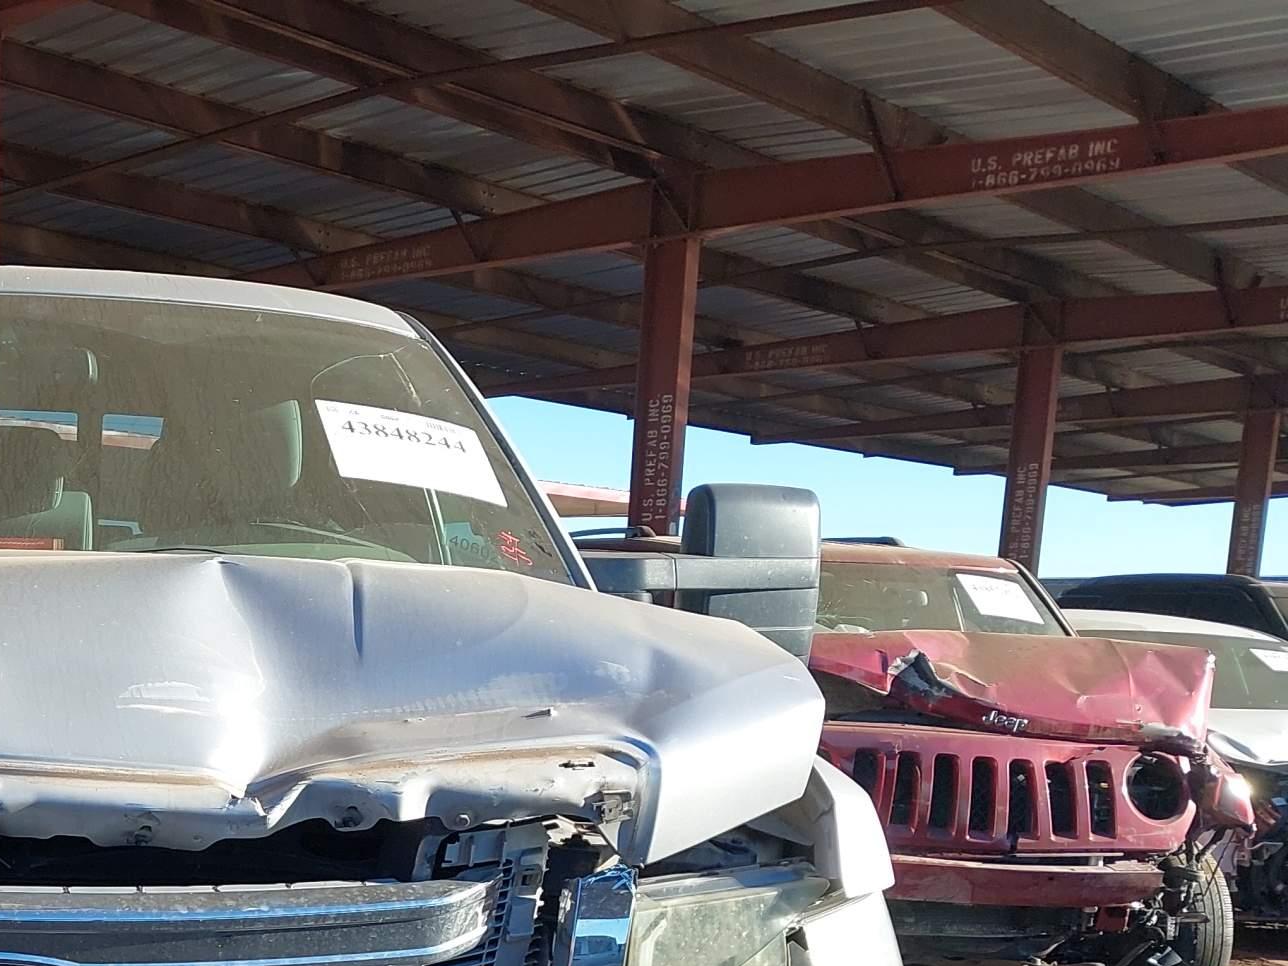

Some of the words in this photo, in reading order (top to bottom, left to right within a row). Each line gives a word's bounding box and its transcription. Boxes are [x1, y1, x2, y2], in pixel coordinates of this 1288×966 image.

[971, 155, 1002, 173] U.S.
[1011, 143, 1080, 167] PREFAB
[648, 394, 661, 422] INC.
[341, 420, 467, 454] 43848244
[644, 430, 658, 486] PREFAB
[654, 394, 673, 520] 1-866-799-0969
[641, 495, 654, 522] U.S.
[982, 710, 1029, 732] Jeep
